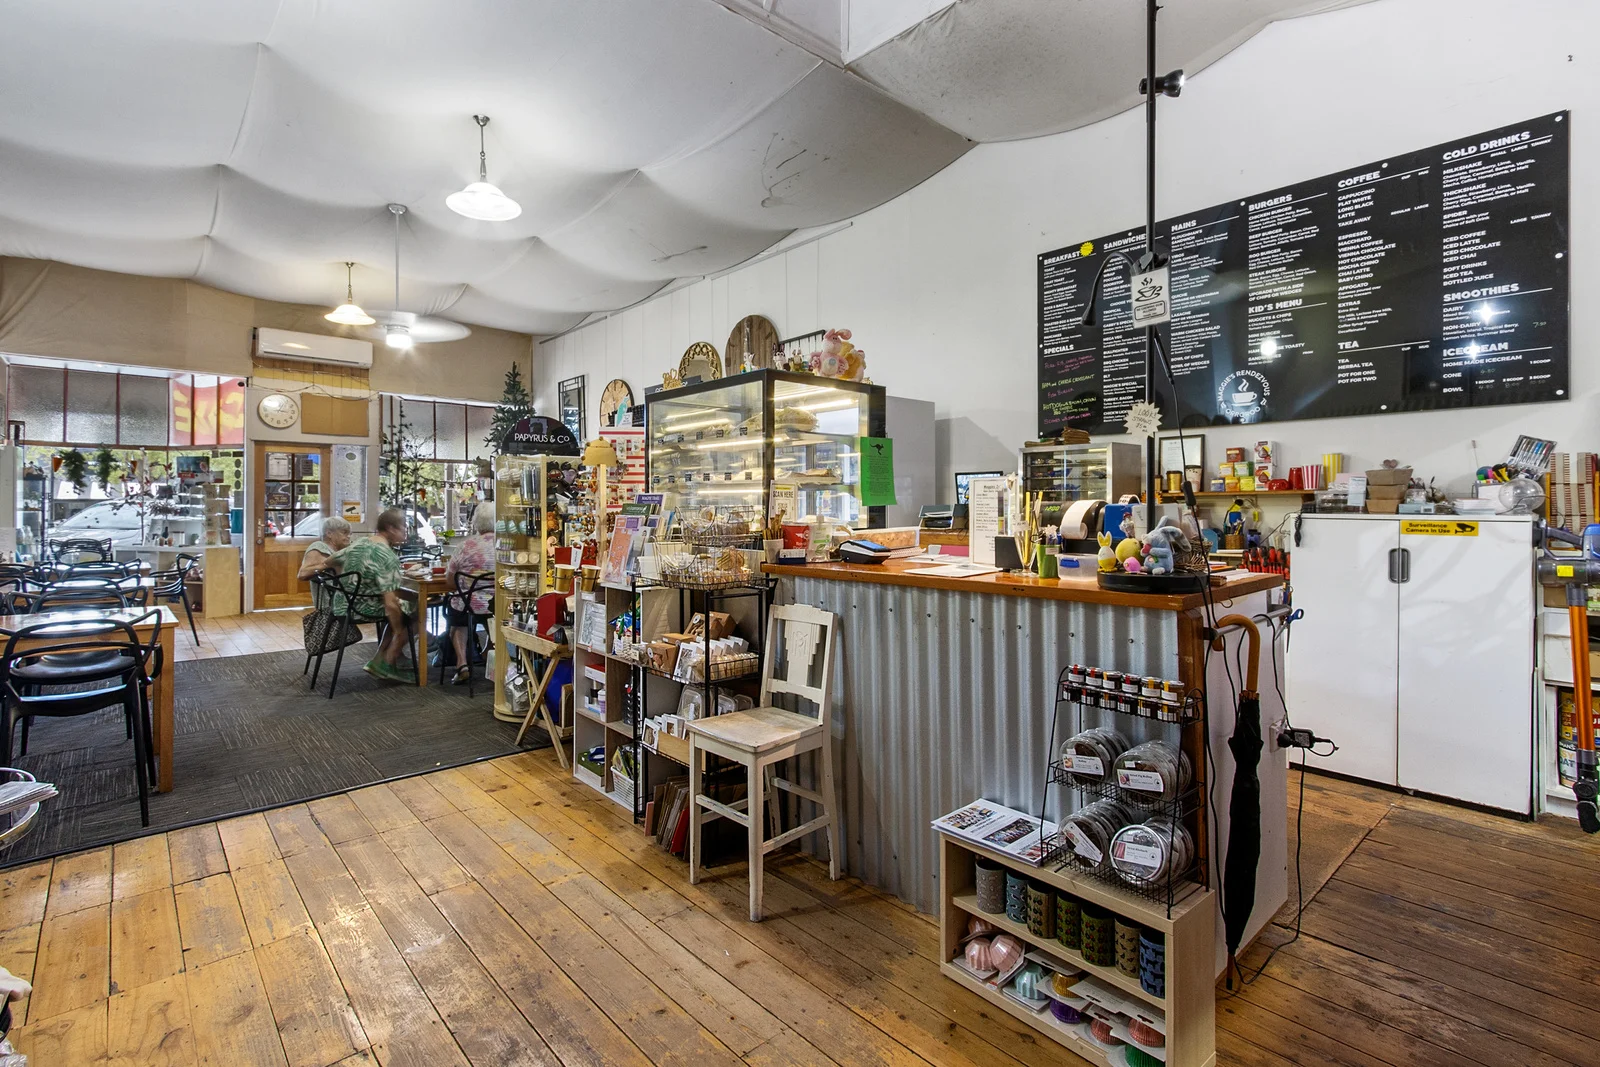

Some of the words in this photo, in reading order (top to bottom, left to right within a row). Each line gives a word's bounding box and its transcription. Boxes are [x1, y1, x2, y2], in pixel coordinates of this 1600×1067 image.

[1442, 145, 1477, 160] COLD
[1480, 131, 1530, 152] DRINKS
[1442, 161, 1482, 175] MILKSHAKE
[1338, 170, 1380, 188] COFFEE
[1338, 188, 1375, 201] CAPPUCCINO
[1442, 183, 1486, 197] THICKSHAKE
[1248, 194, 1292, 212] BURGERS
[1338, 199, 1352, 207] FLAT
[1352, 195, 1371, 203] WHITE
[1338, 205, 1354, 213] LONG
[1354, 201, 1374, 209] BLACK
[1248, 212, 1270, 221] CHICKEN
[1271, 206, 1292, 215] BURGER
[1338, 211, 1356, 219] LATTE
[1442, 210, 1467, 220] SPIDER
[1171, 220, 1197, 232] MAINS
[1262, 228, 1282, 236] BURGER
[1338, 230, 1368, 241] ESPRESSO
[1460, 230, 1486, 239] COFFEE
[1104, 234, 1146, 250] SANDWICHE
[1338, 236, 1372, 246] MACCHIATO
[1338, 244, 1360, 253] VIENNA
[1361, 239, 1383, 248] COFFEE
[1460, 241, 1501, 253] CHOCOLATE
[1338, 250, 1360, 258] VIENNA
[1361, 243, 1396, 254] CHOCOLATE
[1044, 251, 1080, 265] BREAKFAST
[1351, 252, 1386, 262] CHOCOLATE
[1461, 260, 1487, 270] DRINKS
[1442, 278, 1473, 286] BOTTLED
[1474, 273, 1494, 282] JUICE
[1338, 282, 1369, 291] AFFOGATO
[1442, 283, 1520, 302] SMOOTHIES
[1248, 303, 1274, 314] KID'S
[1275, 299, 1303, 309] MENU
[1442, 321, 1481, 331] NON-DAIRY
[1044, 344, 1074, 355] SPECIALS
[1338, 340, 1359, 350] TEA
[1442, 342, 1508, 357] ICECEAM
[1486, 355, 1522, 363] ICECREAM
[1218, 372, 1236, 401] MAGGIE'S
[1236, 369, 1270, 396] RENDEZVOUS
[514, 433, 548, 442] PAPYRUS
[550, 435, 555, 443] &
